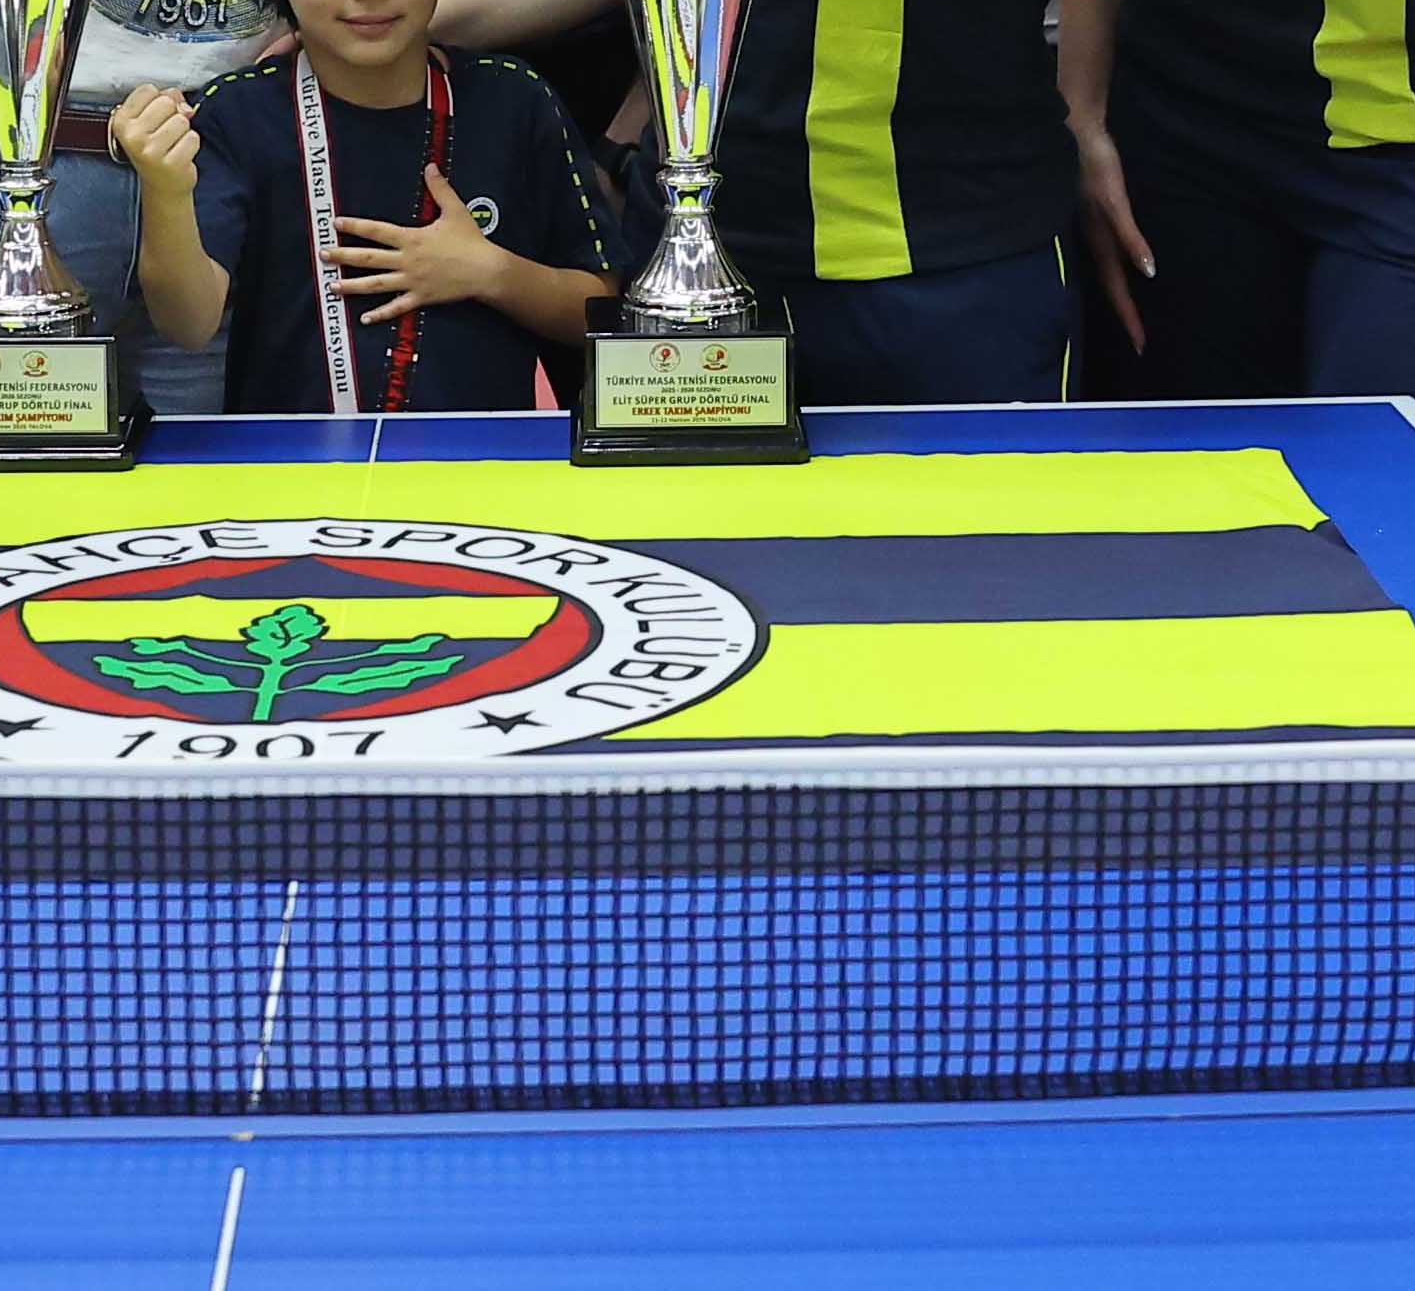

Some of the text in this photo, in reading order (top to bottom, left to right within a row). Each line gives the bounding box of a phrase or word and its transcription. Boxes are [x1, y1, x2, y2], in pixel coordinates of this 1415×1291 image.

[300, 73, 351, 394] Türkiye Masa Teni Federasyonu
[606, 375, 777, 386] TÜRKİYE MASA TENİSİ FEDERASYONU
[29, 382, 98, 391] FEDERASYONU
[21, 400, 61, 410] DÖRTLÜ
[64, 399, 93, 410] FİNAL
[612, 394, 771, 405] ELİT SÜPER GRUP DÖRTLÜ FİNAL
[632, 404, 751, 417] ERKEK TAKIM ŞAMPİYONU
[16, 411, 73, 423] ŞAMPİYONU
[307, 524, 609, 576] SPOR
[564, 570, 743, 714] KULÜBÜ
